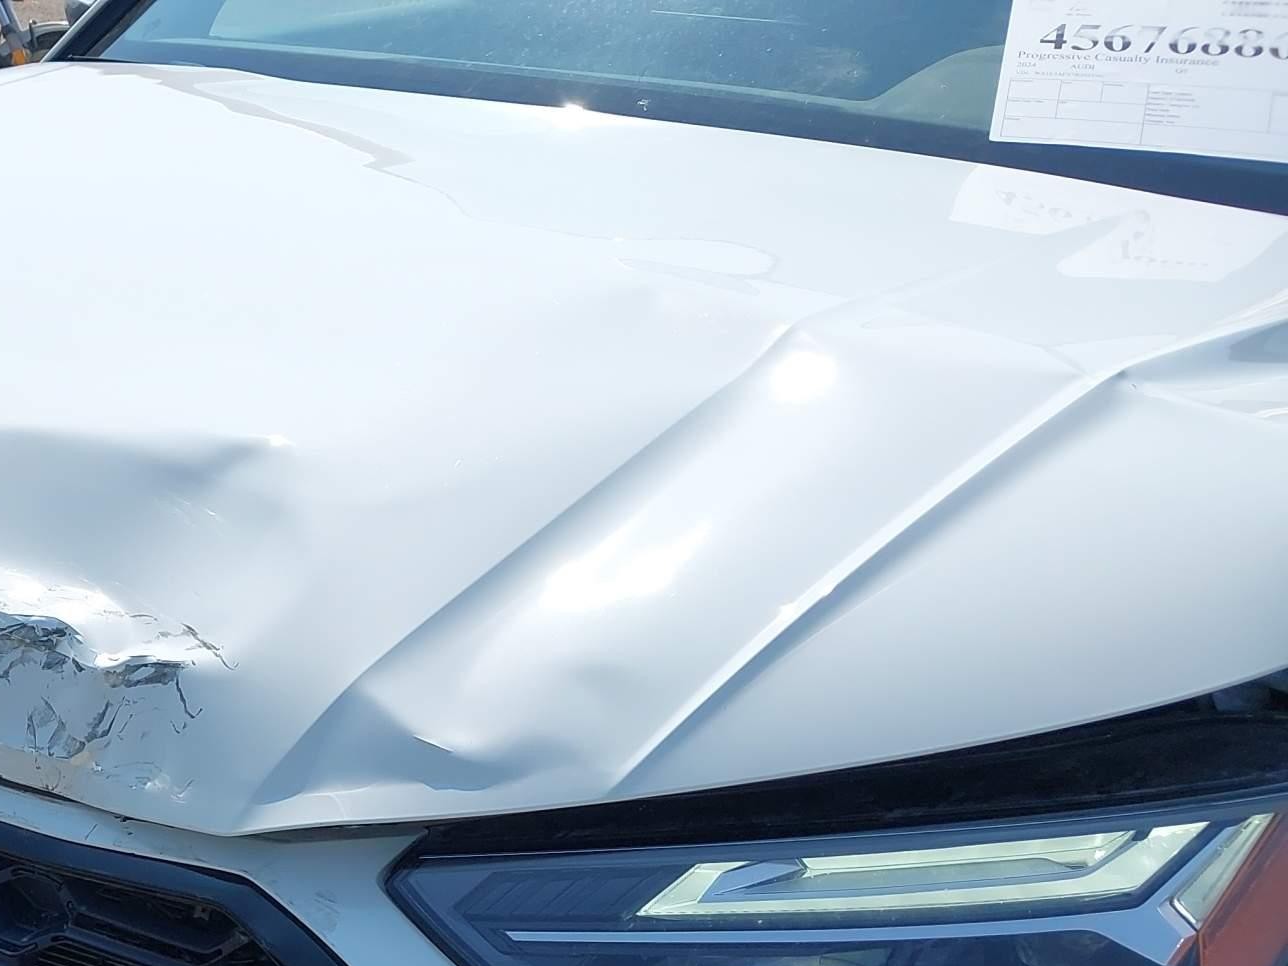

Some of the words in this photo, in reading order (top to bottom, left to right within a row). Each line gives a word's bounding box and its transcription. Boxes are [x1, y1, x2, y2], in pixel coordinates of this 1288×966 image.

[1017, 50, 1092, 61] Progressive
[1094, 52, 1151, 64] Casualty
[1155, 55, 1220, 67] Insurance
